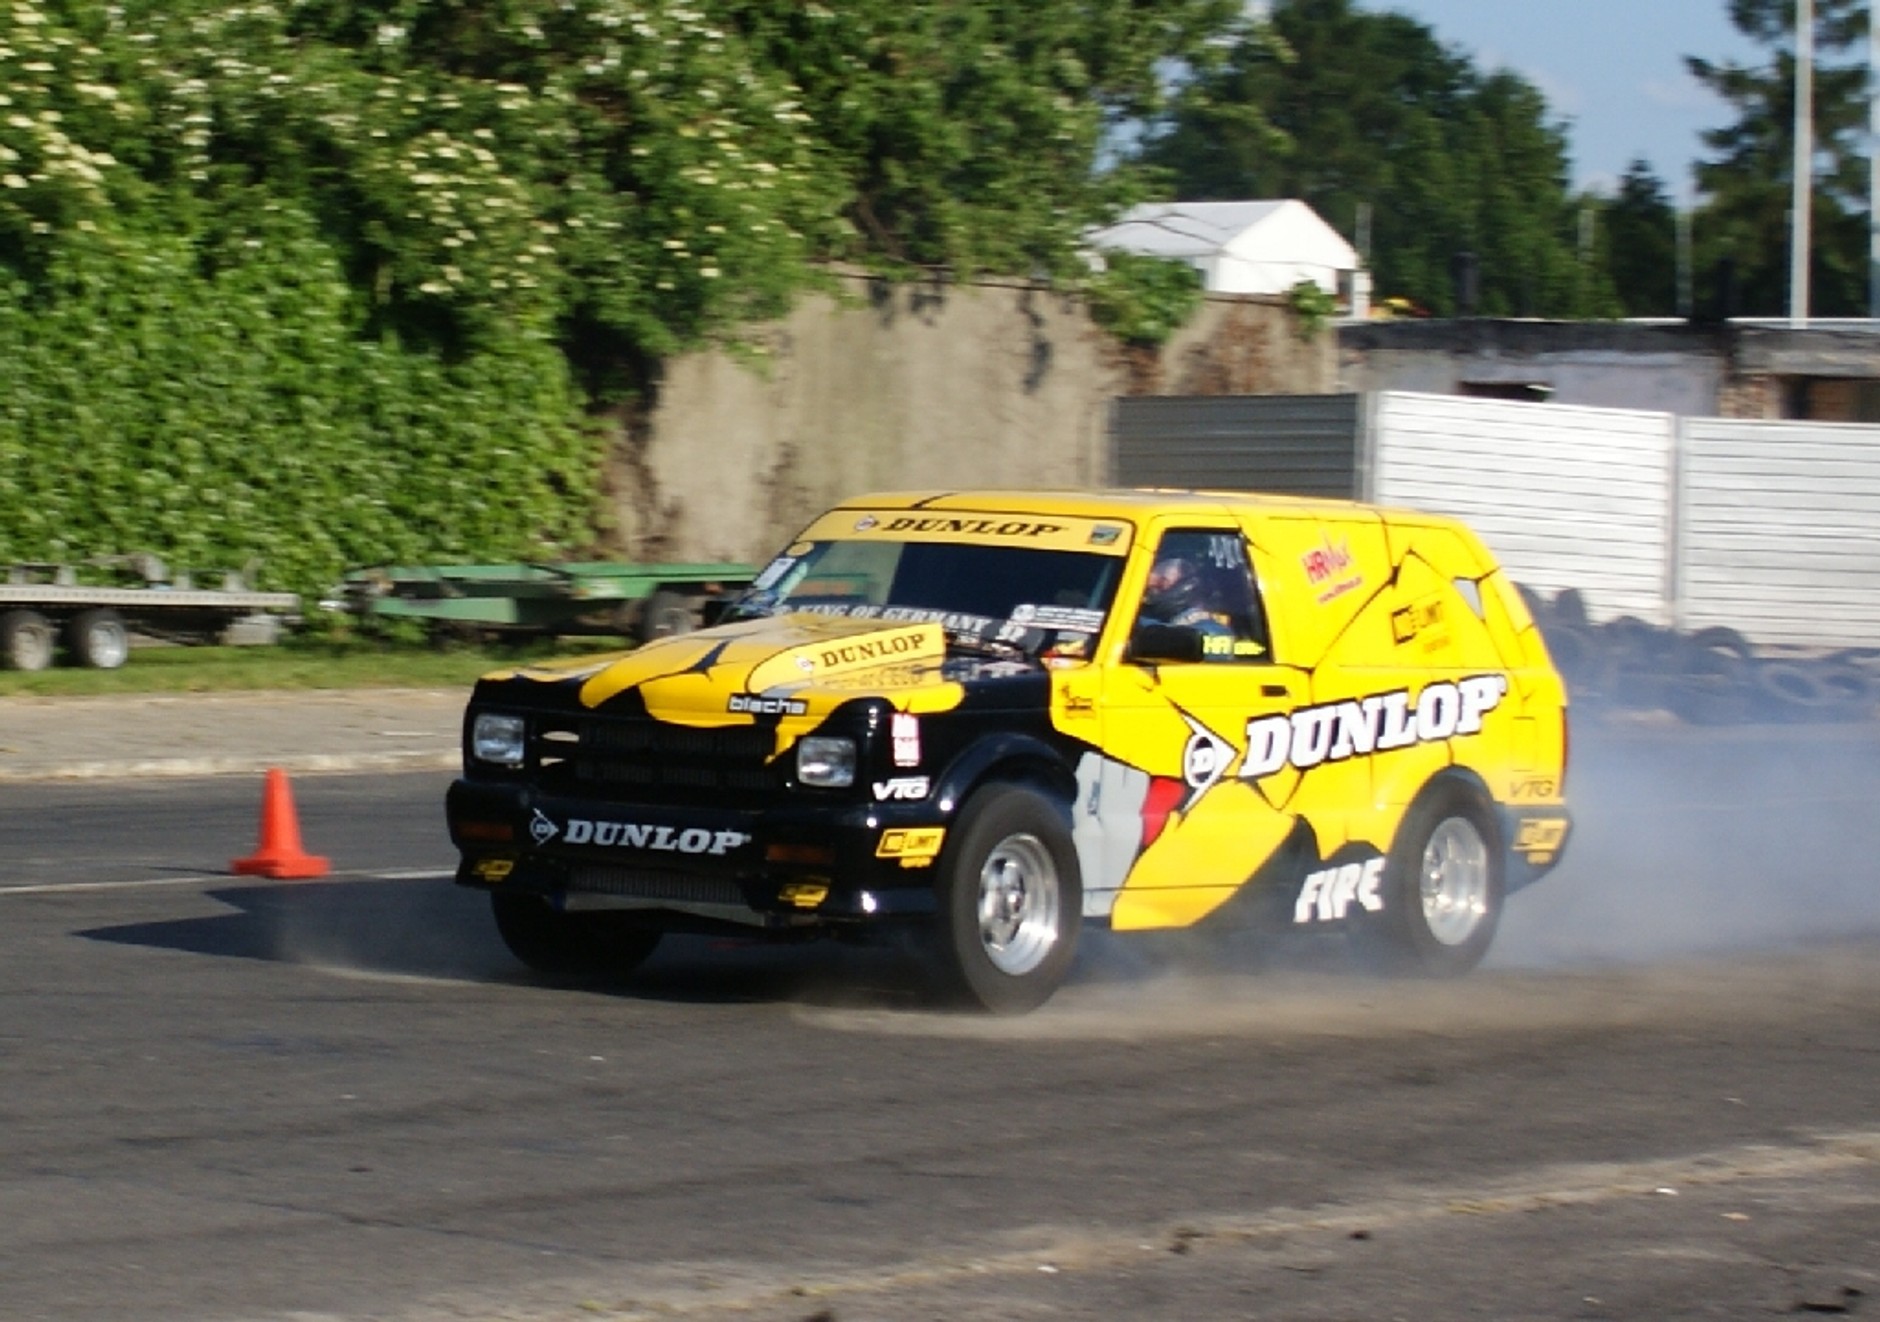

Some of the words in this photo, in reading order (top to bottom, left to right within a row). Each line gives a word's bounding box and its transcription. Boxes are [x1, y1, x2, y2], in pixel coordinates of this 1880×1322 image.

[882, 518, 1064, 538] DUNLOP
[820, 634, 925, 668] DUNLOP
[1238, 675, 1502, 778] DUNLOP
[872, 776, 930, 800] VTG
[1509, 780, 1554, 797] VTG
[563, 819, 744, 854] DUNLOP
